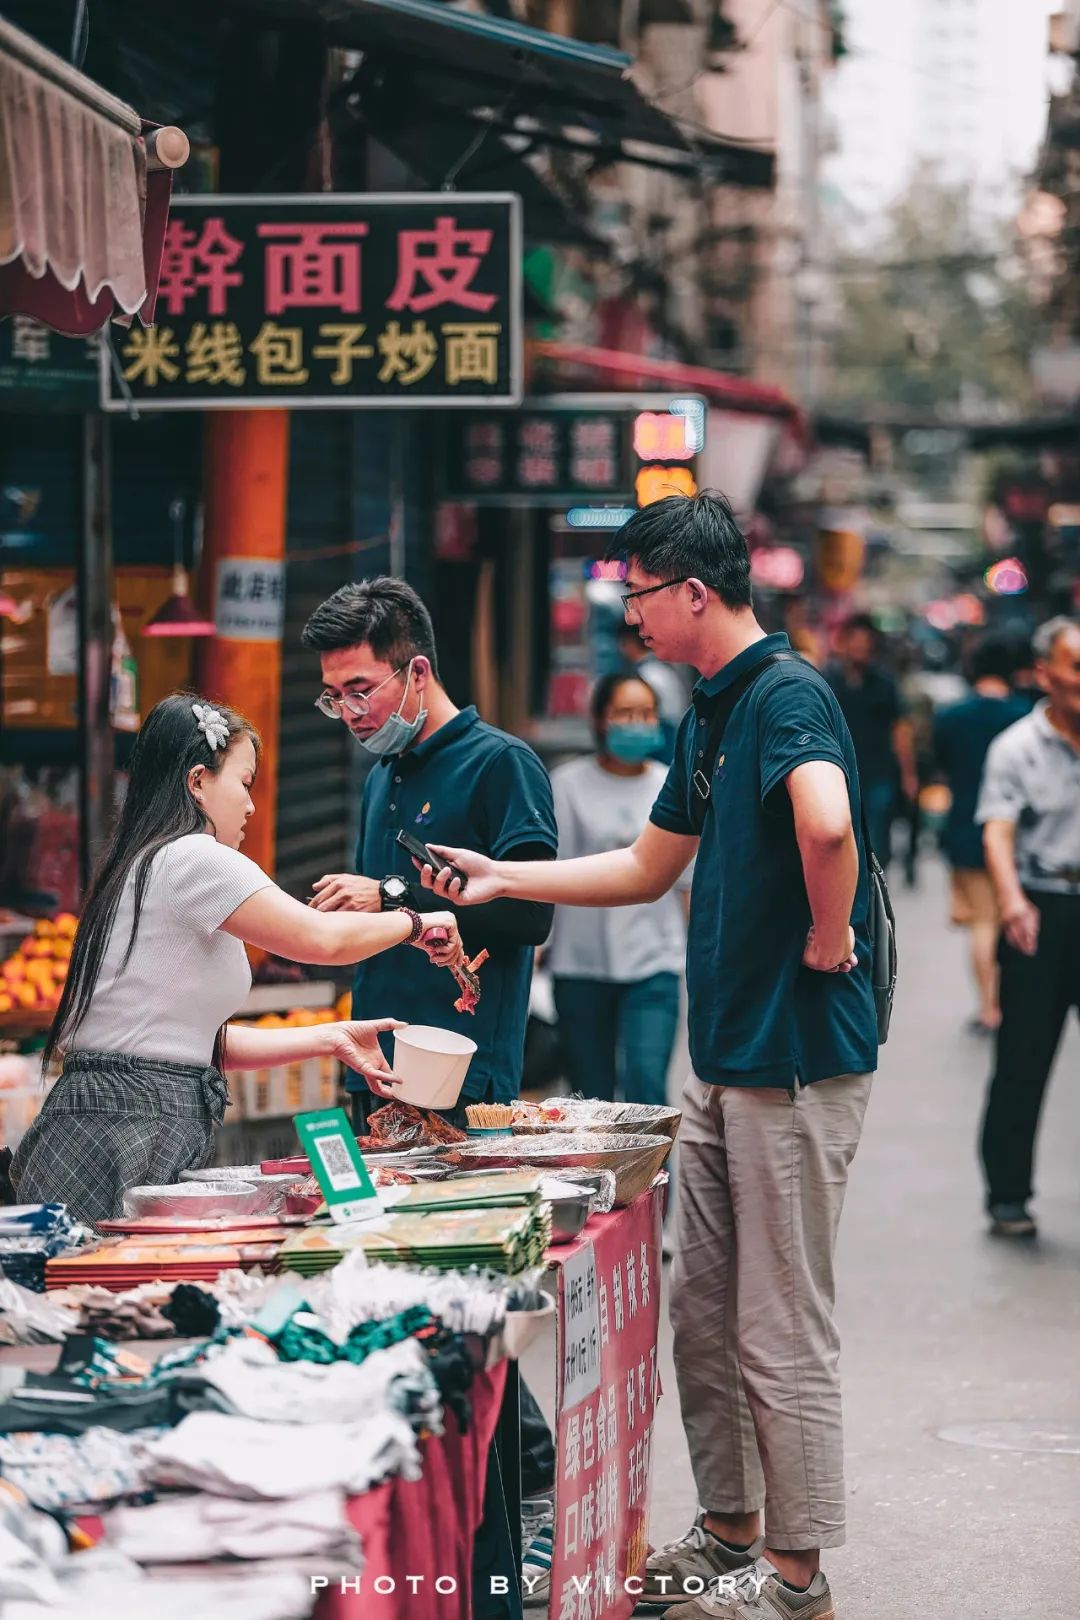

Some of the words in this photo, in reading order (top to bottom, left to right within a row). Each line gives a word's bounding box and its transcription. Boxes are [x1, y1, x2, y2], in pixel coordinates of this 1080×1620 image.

[122, 322, 502, 388] 米线包子炒面
[564, 1383, 619, 1481] 绿色食品
[563, 1460, 619, 1561] 口味独特
